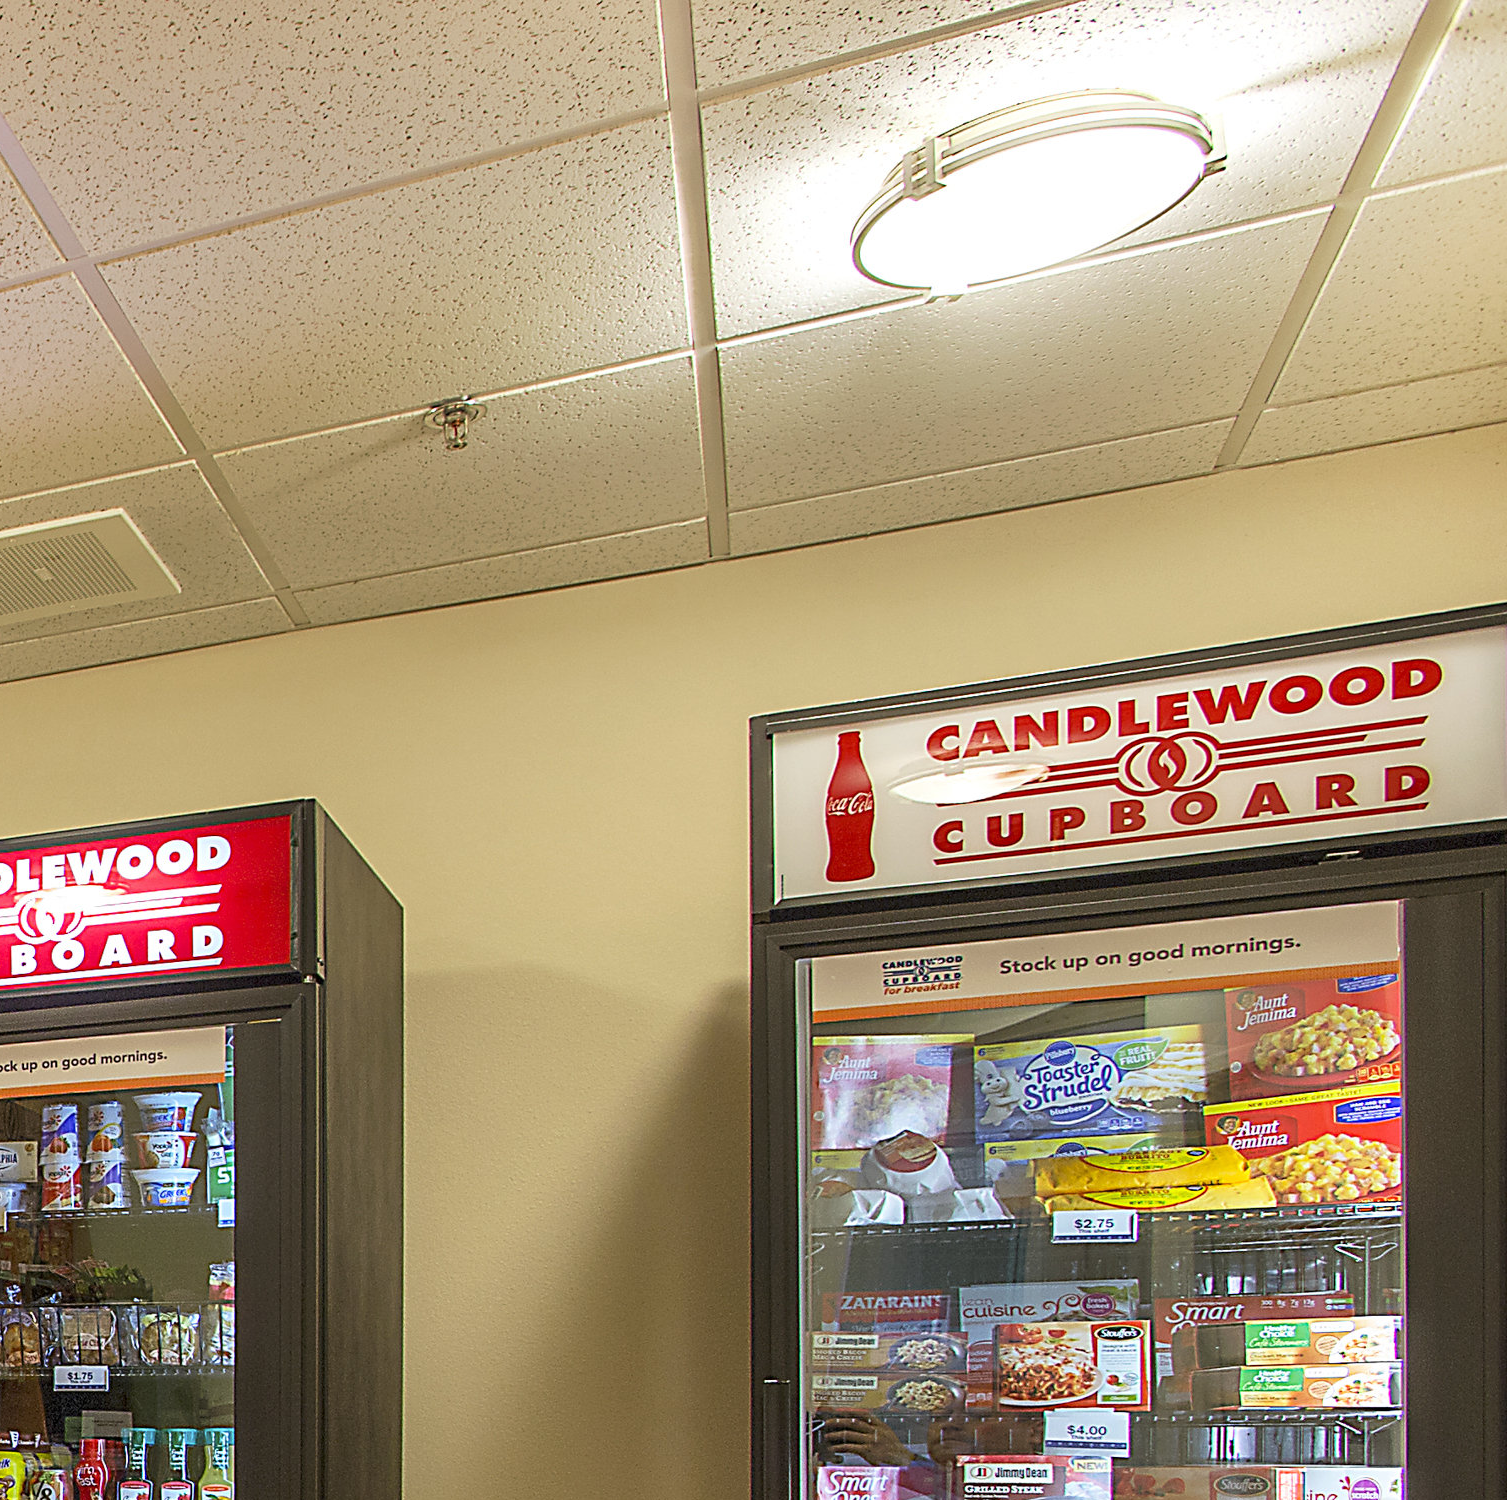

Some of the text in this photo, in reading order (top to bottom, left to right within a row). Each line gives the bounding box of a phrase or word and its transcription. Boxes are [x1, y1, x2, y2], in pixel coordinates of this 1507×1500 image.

[925, 657, 1444, 765] CANDLEWOOD
[932, 764, 1431, 855] CUPBOARD
[999, 935, 1302, 976] Stock up on good mornings.
[882, 971, 963, 986] CUPBOARD
[883, 980, 961, 996] for breakfast
[1253, 992, 1289, 1015] Aunt
[1236, 1005, 1297, 1031] Jemima
[21, 1061, 38, 1074] up
[41, 1059, 59, 1069] on
[61, 1053, 97, 1069] good
[100, 1049, 169, 1067] mornings.
[1029, 1056, 1102, 1086] Toaster
[1021, 1072, 1112, 1110] Strudel
[1235, 1118, 1281, 1138] Aunt
[1225, 1130, 1289, 1151] Jemima
[1073, 1215, 1115, 1232] $2.75
[962, 1300, 1037, 1318] cuisine
[67, 1371, 94, 1381] $1.75
[1066, 1423, 1108, 1438] $4.00
[825, 1472, 888, 1495] Smart
